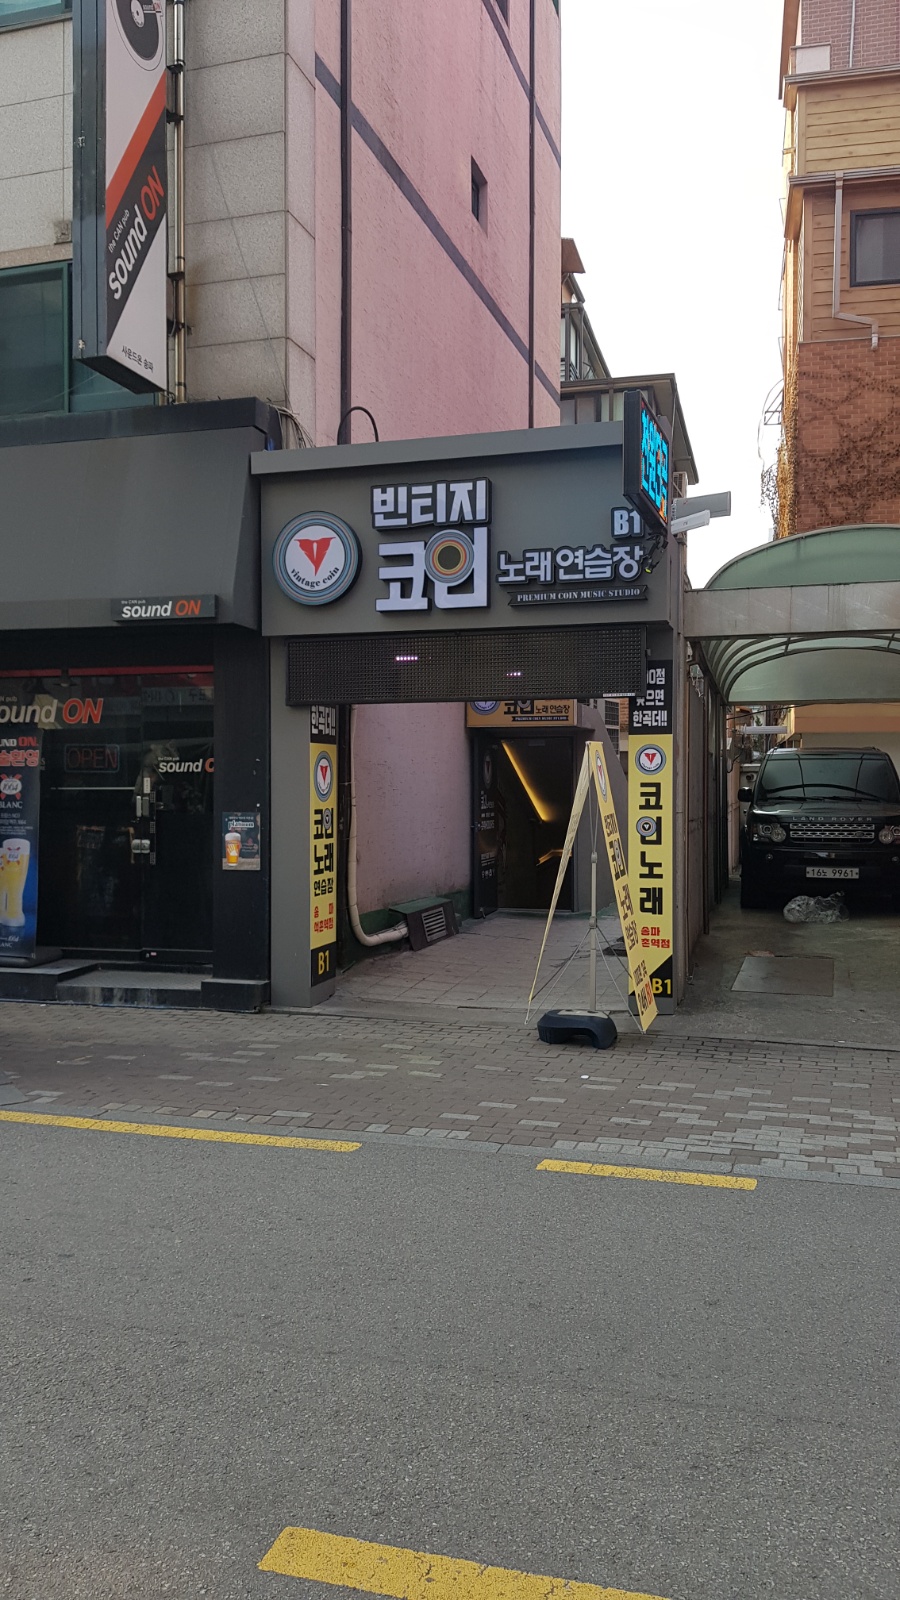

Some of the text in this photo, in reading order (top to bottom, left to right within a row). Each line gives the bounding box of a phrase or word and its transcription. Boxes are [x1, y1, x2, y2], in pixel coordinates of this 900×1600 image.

[109, 165, 165, 300] sound ON
[113, 221, 124, 240] CAN
[121, 209, 129, 227] pub
[121, 345, 143, 366] 사운드온
[373, 480, 486, 527] 빈티지
[613, 509, 641, 535] B1
[291, 567, 340, 589] vintage coin
[376, 527, 487, 611] 코인
[517, 588, 640, 602] PREMIUM COIN MUSIC STUDIO
[122, 600, 201, 618] sound ON
[62, 698, 104, 724] ON
[633, 711, 668, 727] 한곡더!!
[66, 748, 119, 769] OPEN
[158, 758, 204, 772] sound
[313, 808, 334, 839] 코인
[313, 843, 334, 875] 노래
[609, 837, 627, 880] 코인
[811, 868, 854, 878] 16노 9961
[313, 877, 334, 897] 연습장
[617, 884, 634, 921] 노래
[641, 927, 660, 937] 송파
[318, 950, 330, 975] B1
[652, 978, 672, 995] B1
